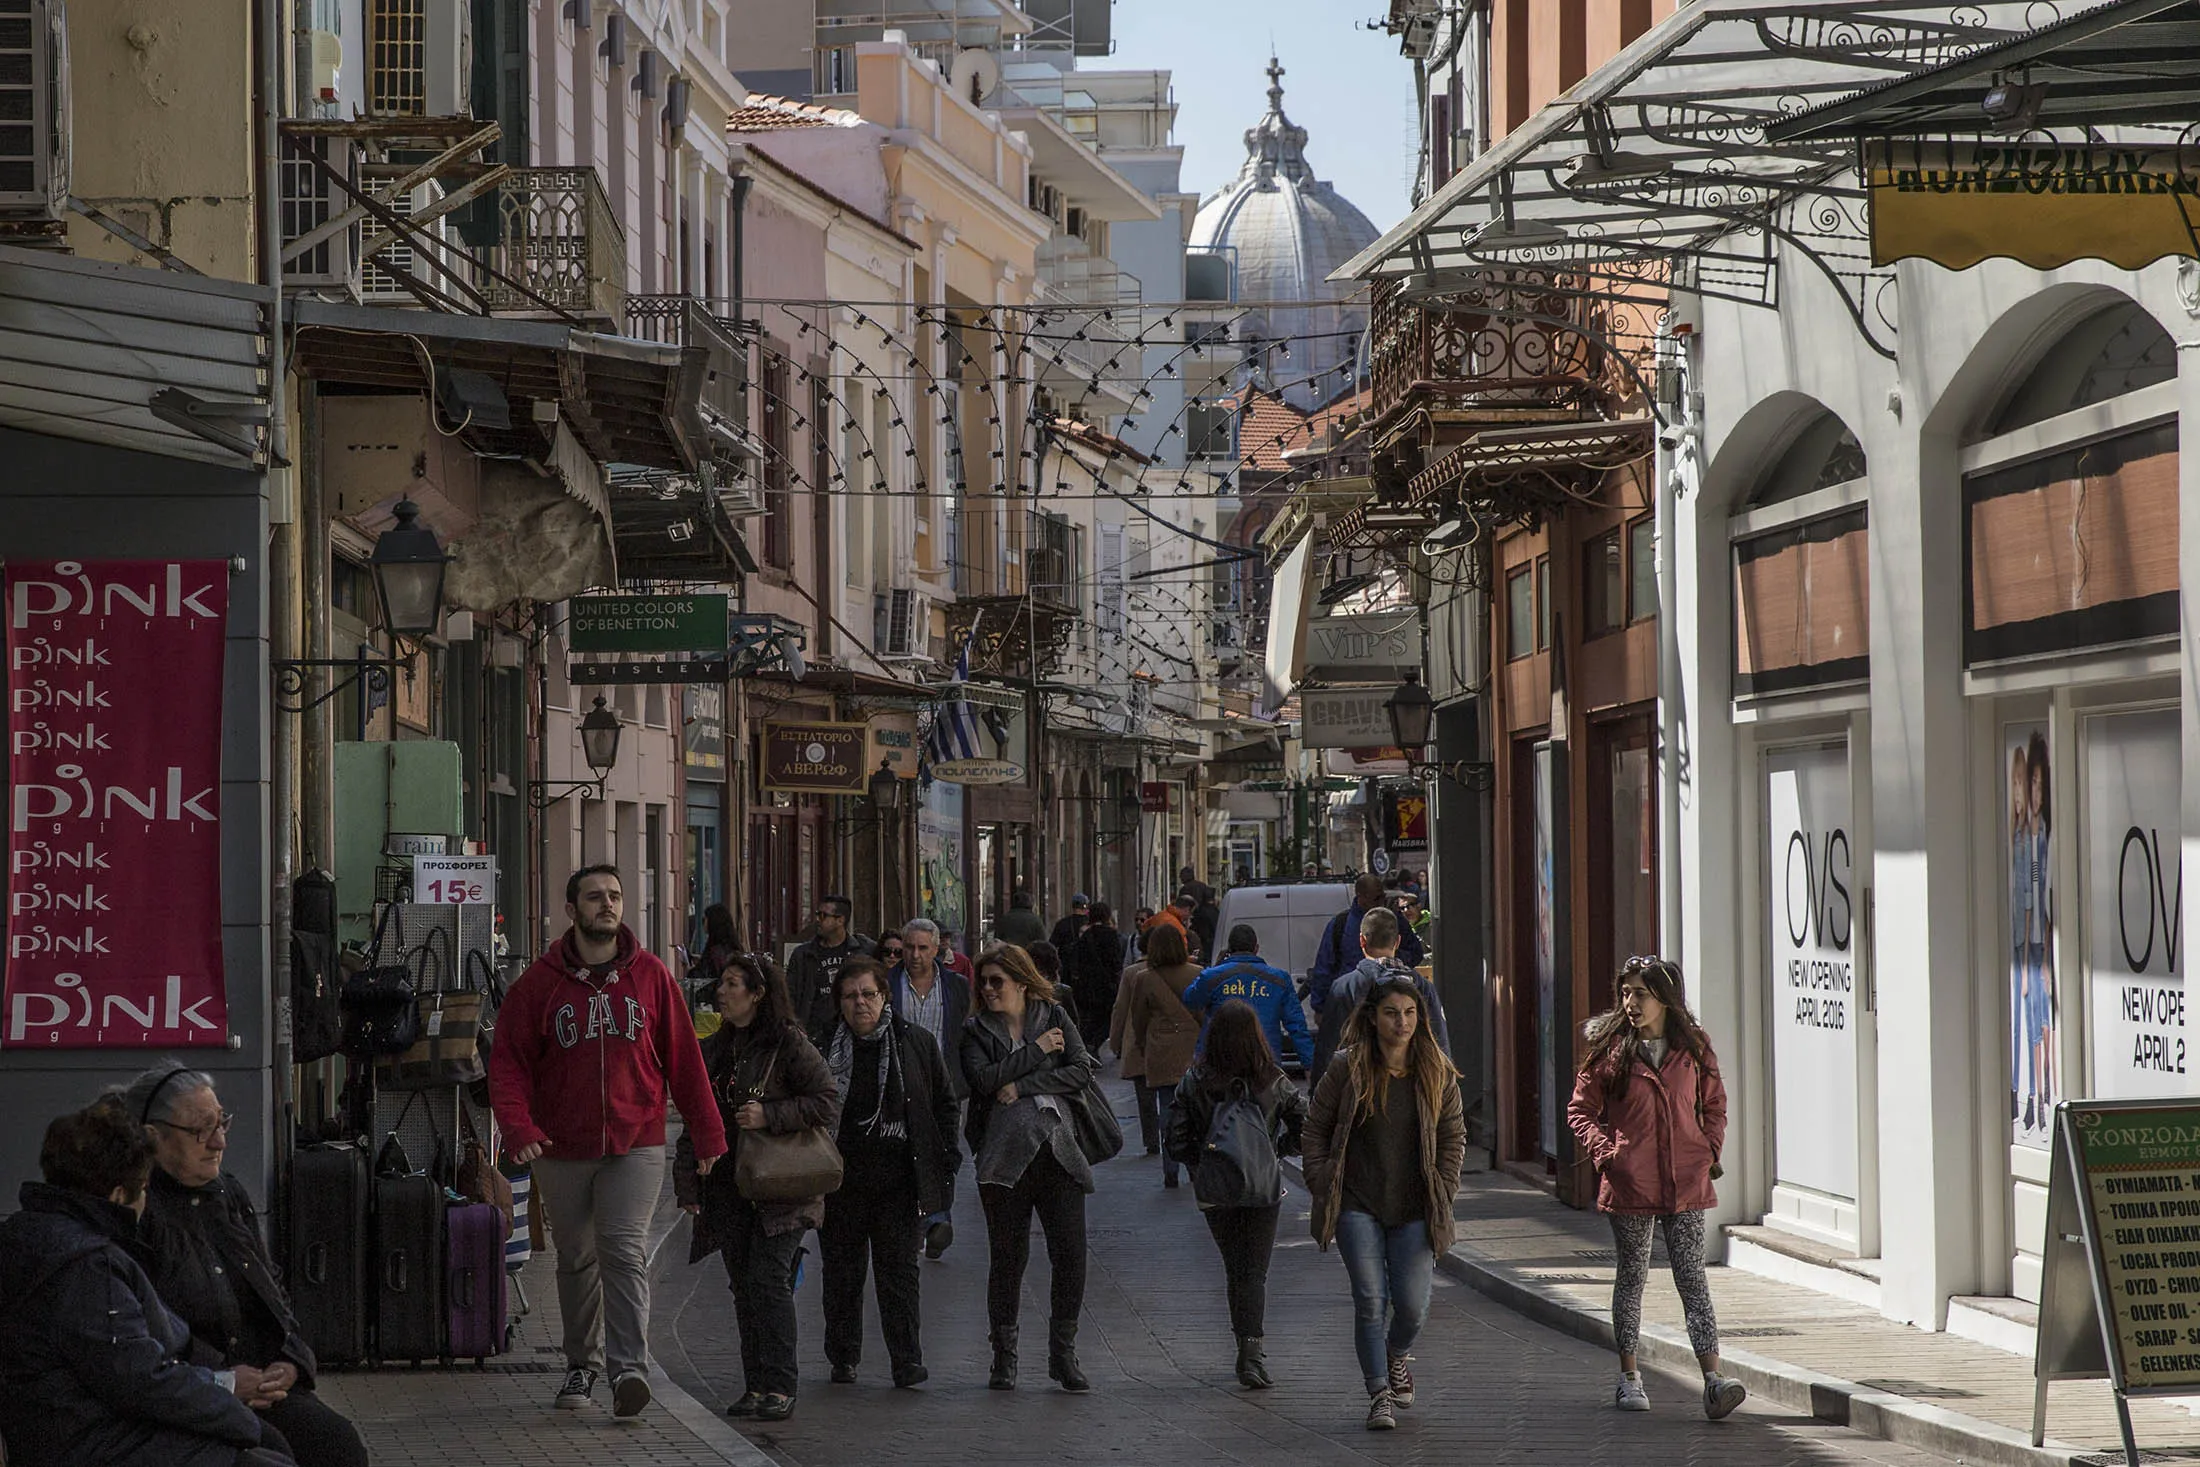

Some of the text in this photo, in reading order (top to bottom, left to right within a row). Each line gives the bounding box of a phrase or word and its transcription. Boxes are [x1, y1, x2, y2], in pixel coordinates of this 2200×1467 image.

[575, 601, 694, 615] UNITED COLORS
[53, 619, 194, 631] girl
[575, 617, 680, 631] OF BENETTON.
[588, 664, 712, 676] SISLEY
[780, 731, 852, 743] ΕΣΤΙΑΤΟΡΙΟ
[782, 762, 848, 776] ΑΒΕΡΩΦ
[53, 822, 194, 834] girl
[423, 862, 488, 870] ΠΡΟΣΦΟΡΕΣ
[428, 880, 482, 904] 15€
[1786, 828, 1850, 951] OVS
[1788, 959, 1850, 992] NEW OPENING
[1223, 980, 1245, 995] aek
[1795, 997, 1844, 1030] APRIL 2016
[2122, 986, 2184, 1026] NEW OPE
[556, 994, 646, 1048] GAP
[51, 1030, 193, 1042] girl
[2133, 1033, 2185, 1074] APRIL 2
[2139, 1147, 2190, 1159] ΕΡΜΟΥ
[2106, 1176, 2183, 1194] ΘΥΜΙΑΜΑΤΑ
[2110, 1202, 2159, 1220] ΤΟΠΙΚΑ
[2114, 1225, 2200, 1245] ΕΙΔΗ ΟΙΚΙΑΚΗ
[2120, 1252, 2160, 1270] LOCAL
[2130, 1304, 2167, 1321] OLIVE
[2168, 1303, 2189, 1320] OIL
[2135, 1329, 2178, 1347] SARAP
